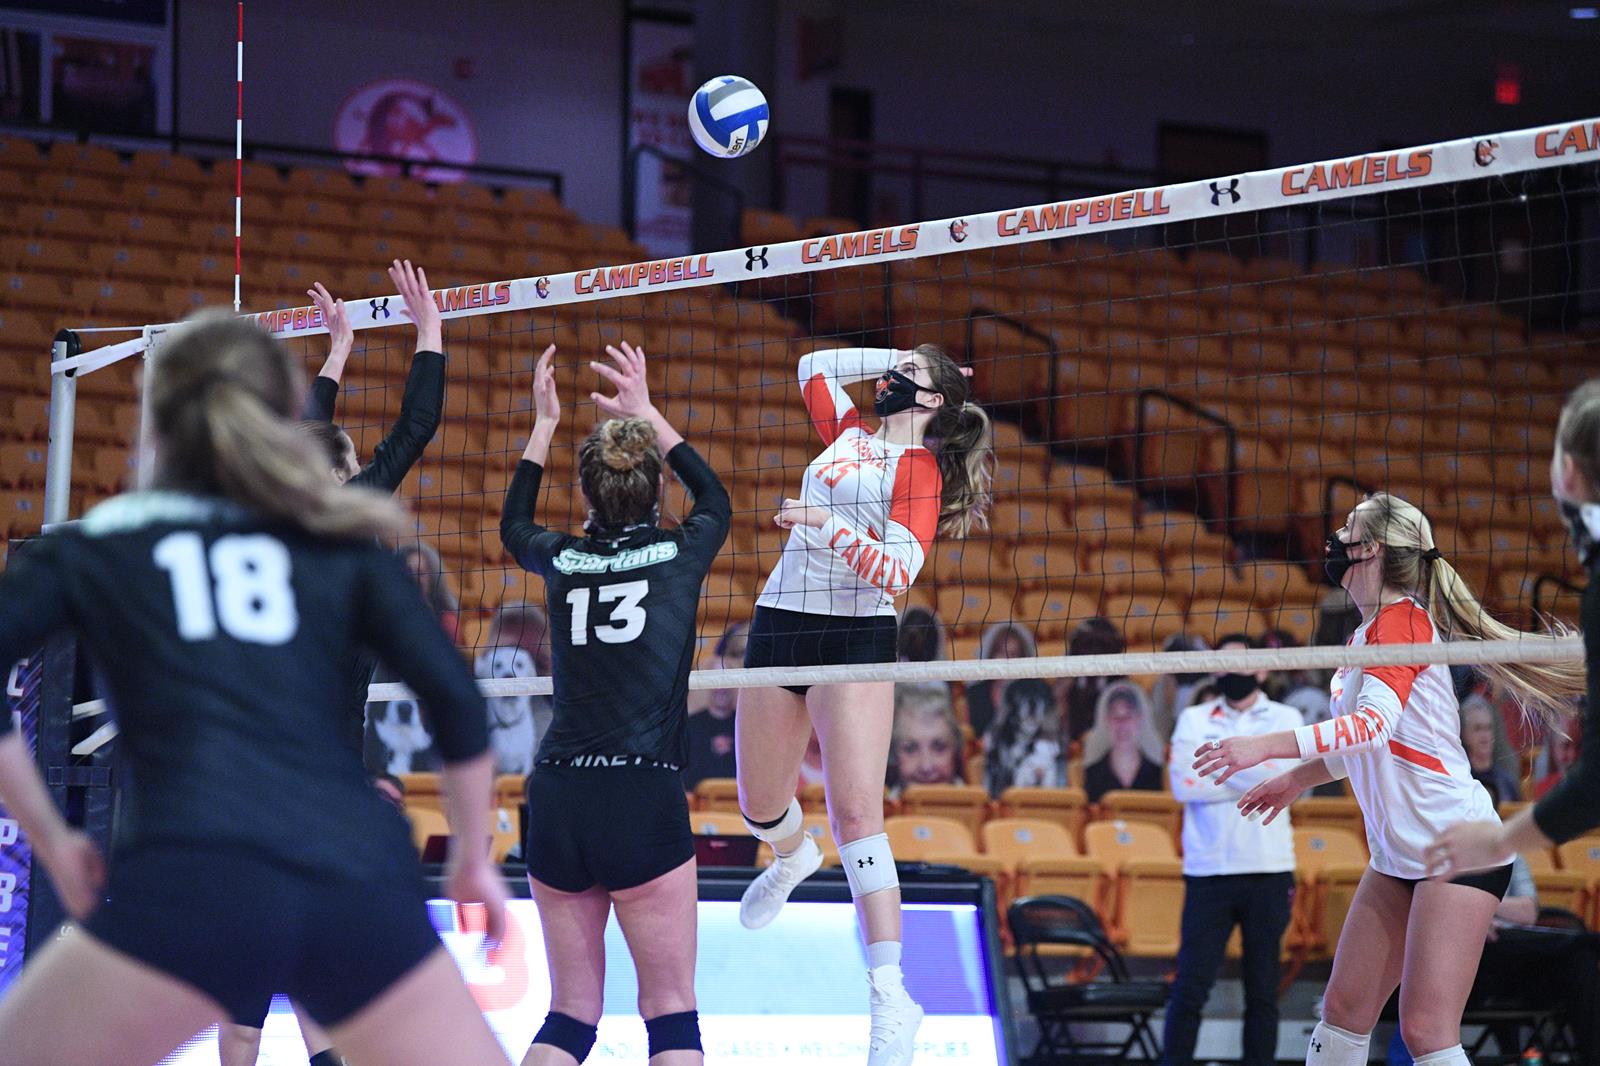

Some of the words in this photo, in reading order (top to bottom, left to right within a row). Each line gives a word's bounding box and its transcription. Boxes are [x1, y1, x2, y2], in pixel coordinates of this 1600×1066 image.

[1281, 149, 1433, 196] CAMELS
[997, 188, 1171, 237] CAMPBELL
[801, 223, 920, 265] CAMELS
[432, 281, 511, 312] AMELS
[574, 255, 715, 294] CAMPBELL
[552, 541, 678, 575] Spartans
[153, 530, 299, 646] 18
[565, 579, 649, 646] 13
